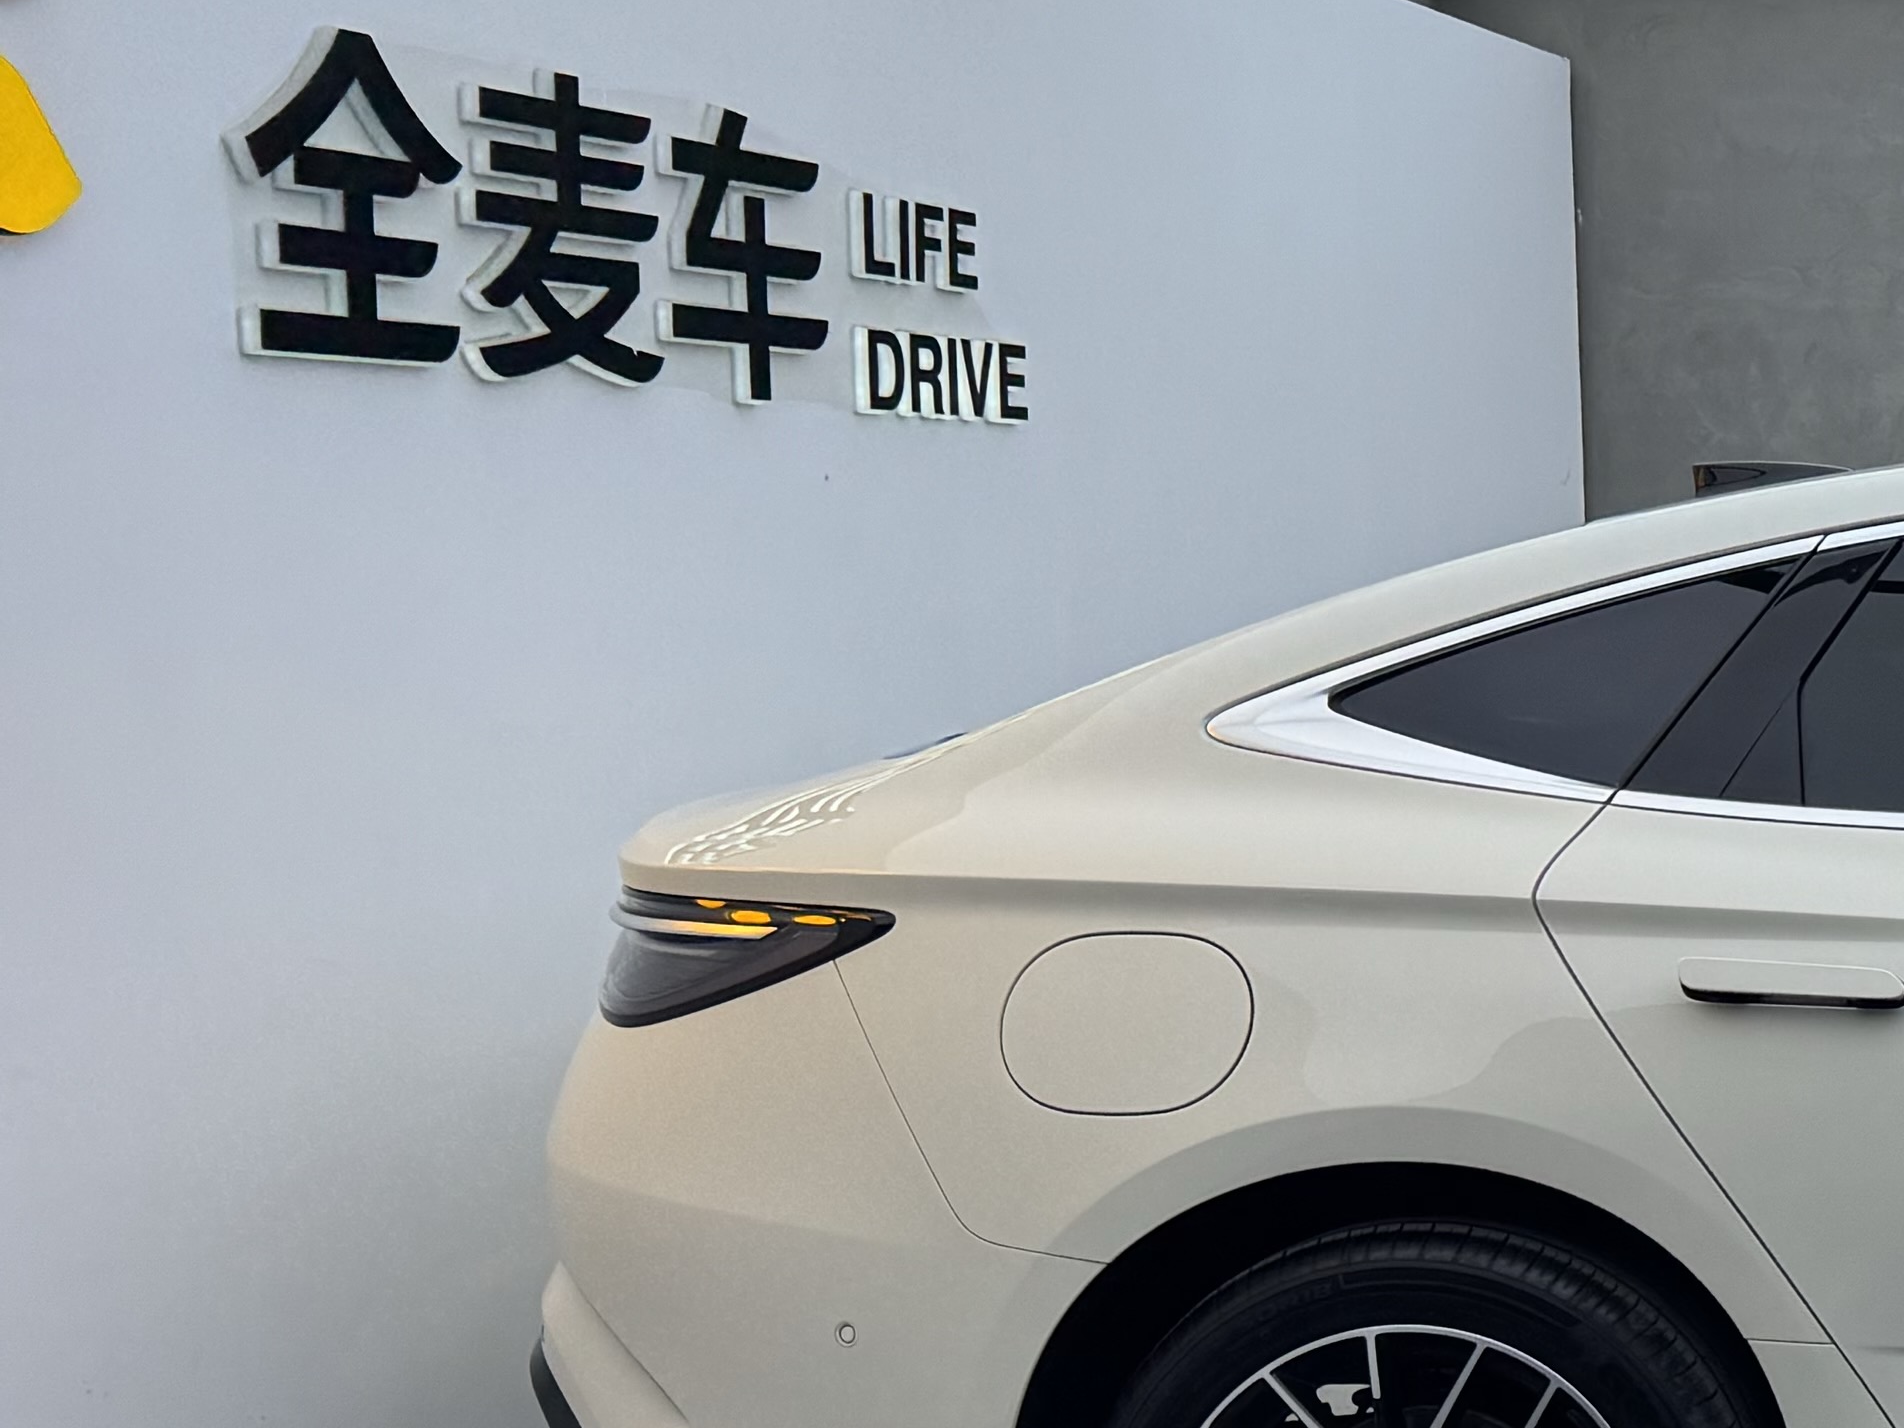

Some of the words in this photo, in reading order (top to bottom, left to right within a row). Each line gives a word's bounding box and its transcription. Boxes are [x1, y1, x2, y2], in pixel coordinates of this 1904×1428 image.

[240, 27, 829, 401] 全麦车
[861, 191, 979, 295] LIFE
[866, 327, 1029, 421] DRIVE
